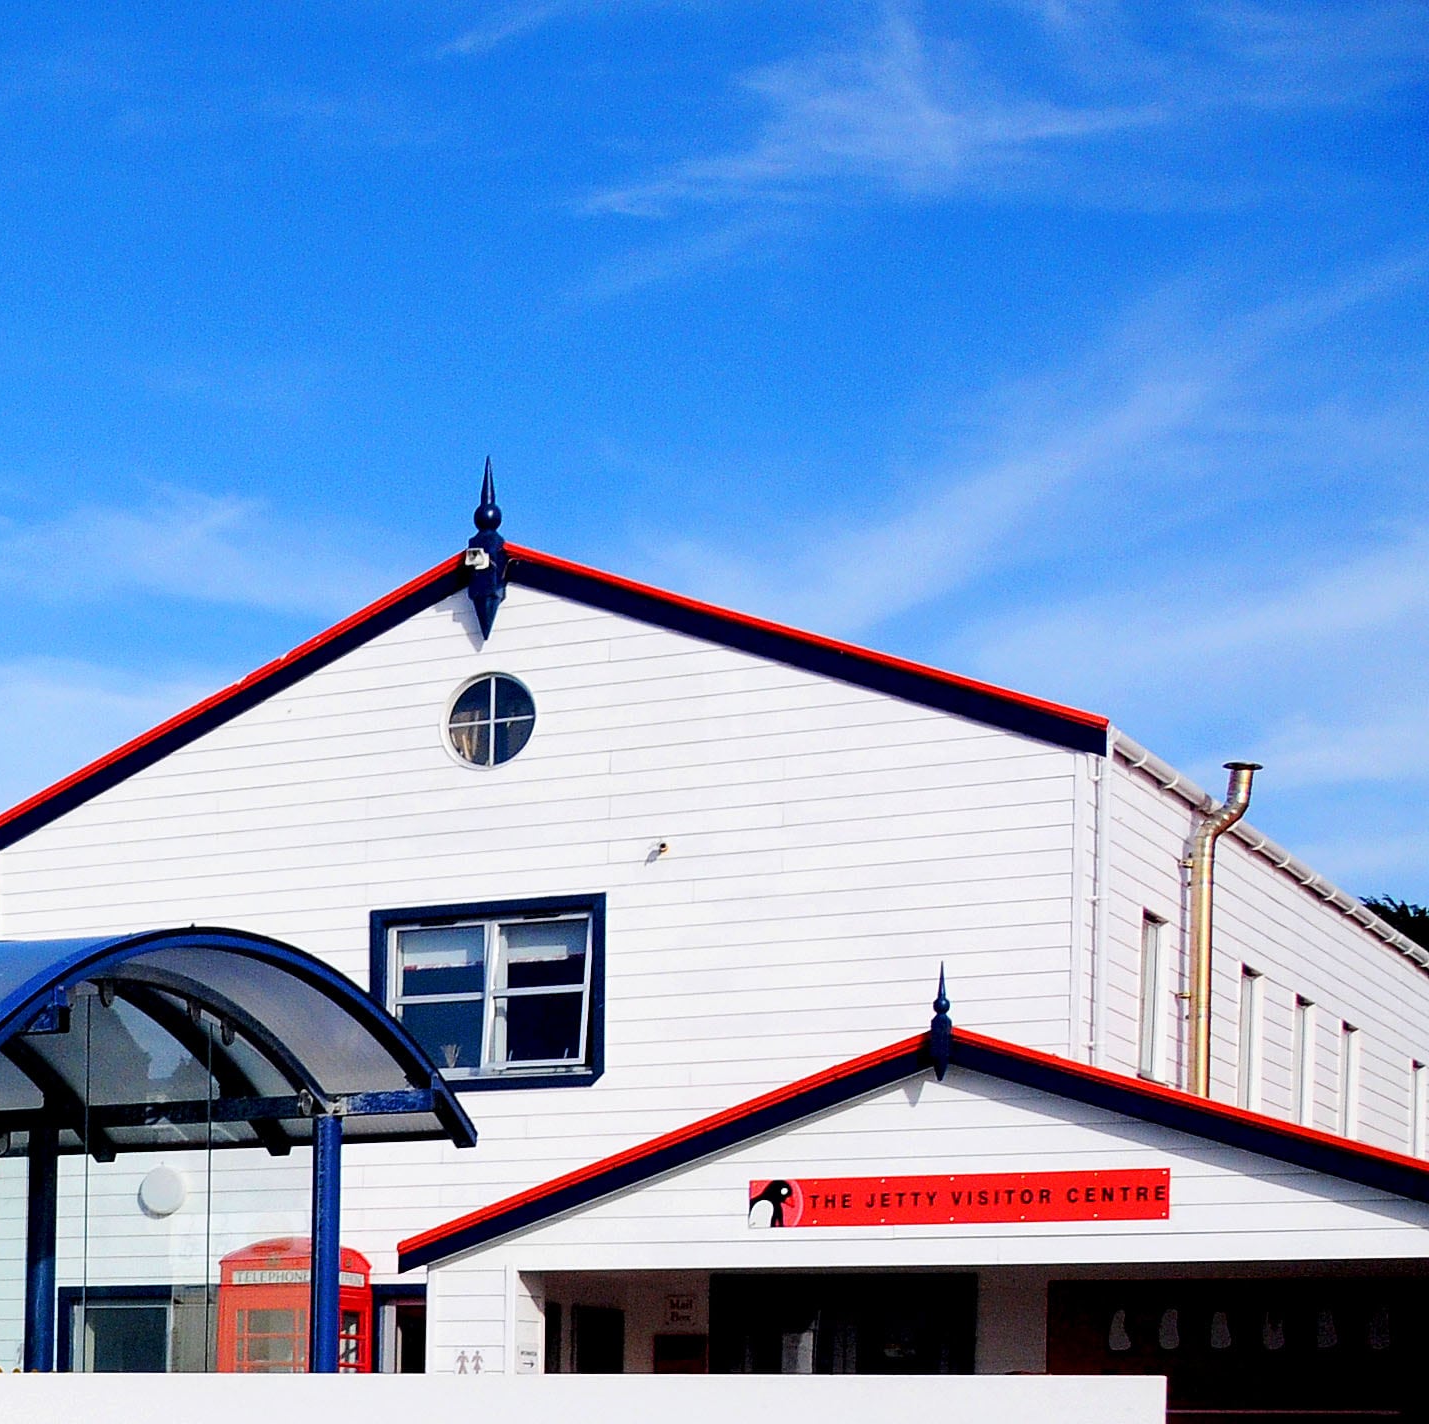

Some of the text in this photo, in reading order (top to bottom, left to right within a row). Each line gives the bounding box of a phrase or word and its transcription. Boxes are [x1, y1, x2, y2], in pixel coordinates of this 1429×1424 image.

[810, 1185, 1166, 1210] THE JETTY VISITOR CENTRE
